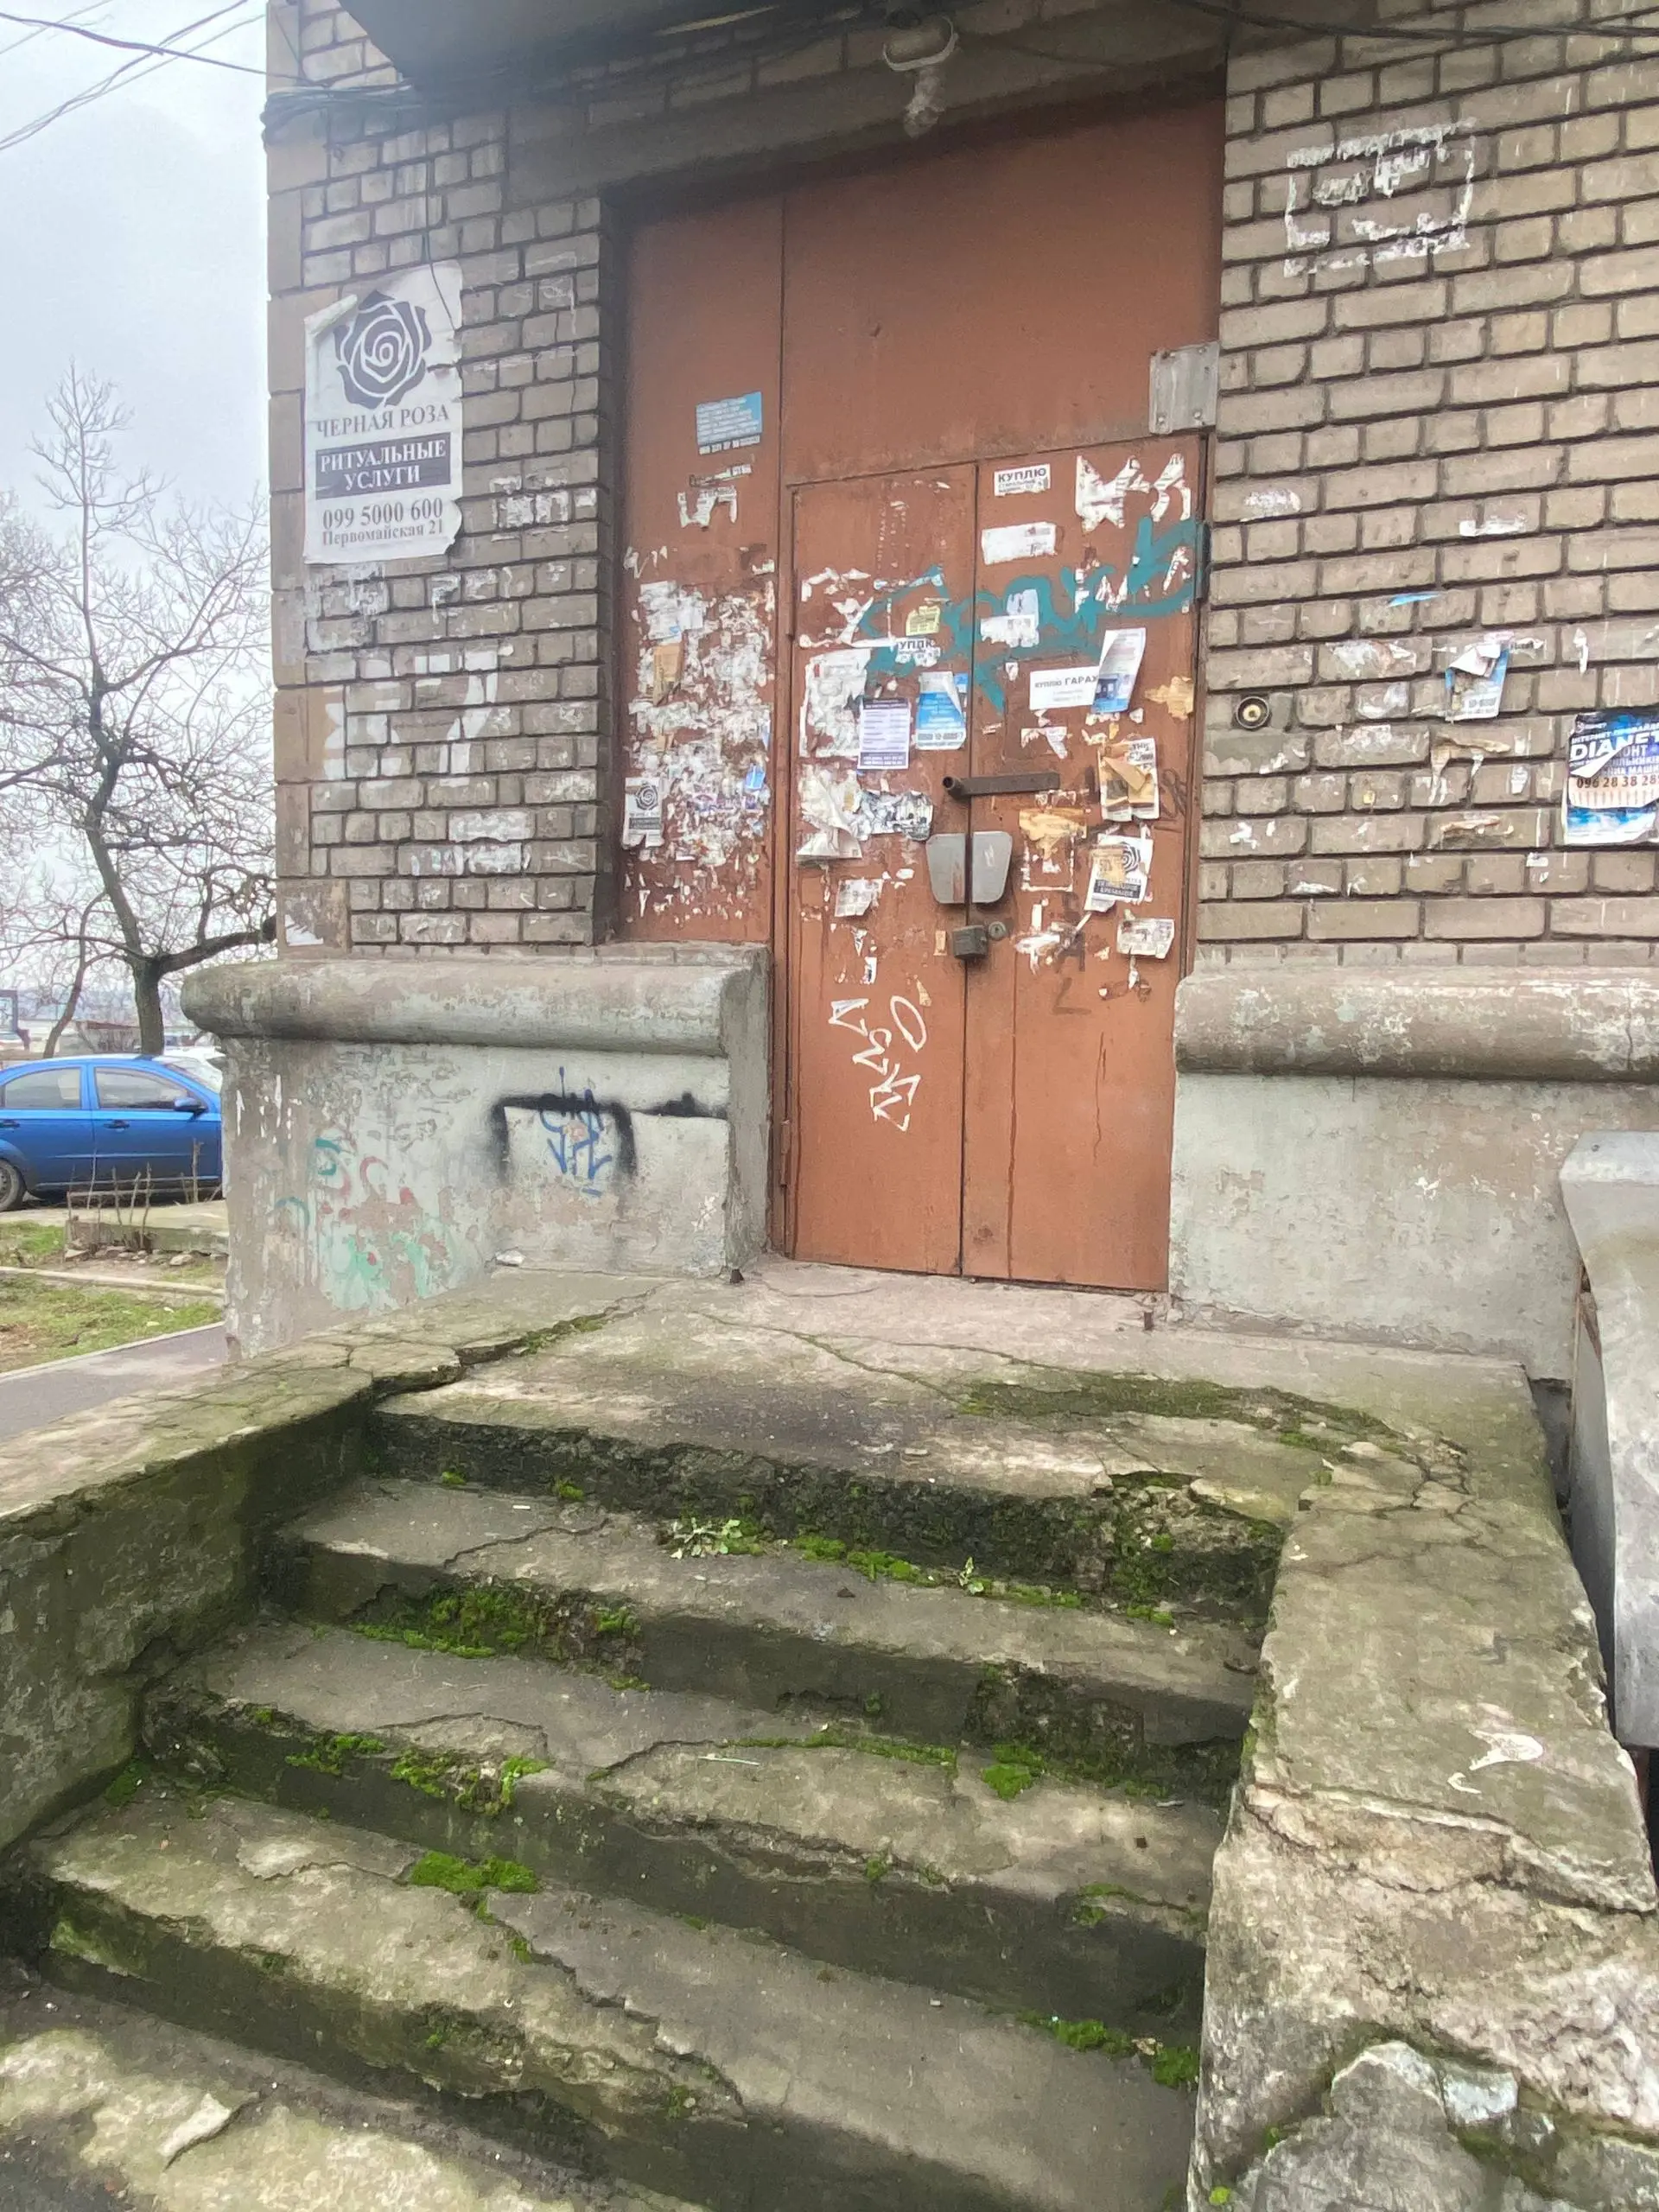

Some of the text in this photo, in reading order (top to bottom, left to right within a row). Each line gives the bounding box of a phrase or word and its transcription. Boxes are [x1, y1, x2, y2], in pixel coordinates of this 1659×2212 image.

[317, 404, 449, 437] ЧЕРНАЯ РОЗА
[321, 439, 446, 472] РИТУАЛЬНЫЕ
[344, 465, 420, 491] УСЛУГИ
[998, 467, 1046, 483] КУПЛЮ
[322, 498, 442, 530] 099 5000 600
[322, 519, 442, 547] Первомайская 21
[1577, 777, 1599, 789] 096
[1603, 777, 1618, 787] 28
[1622, 776, 1637, 787] 38
